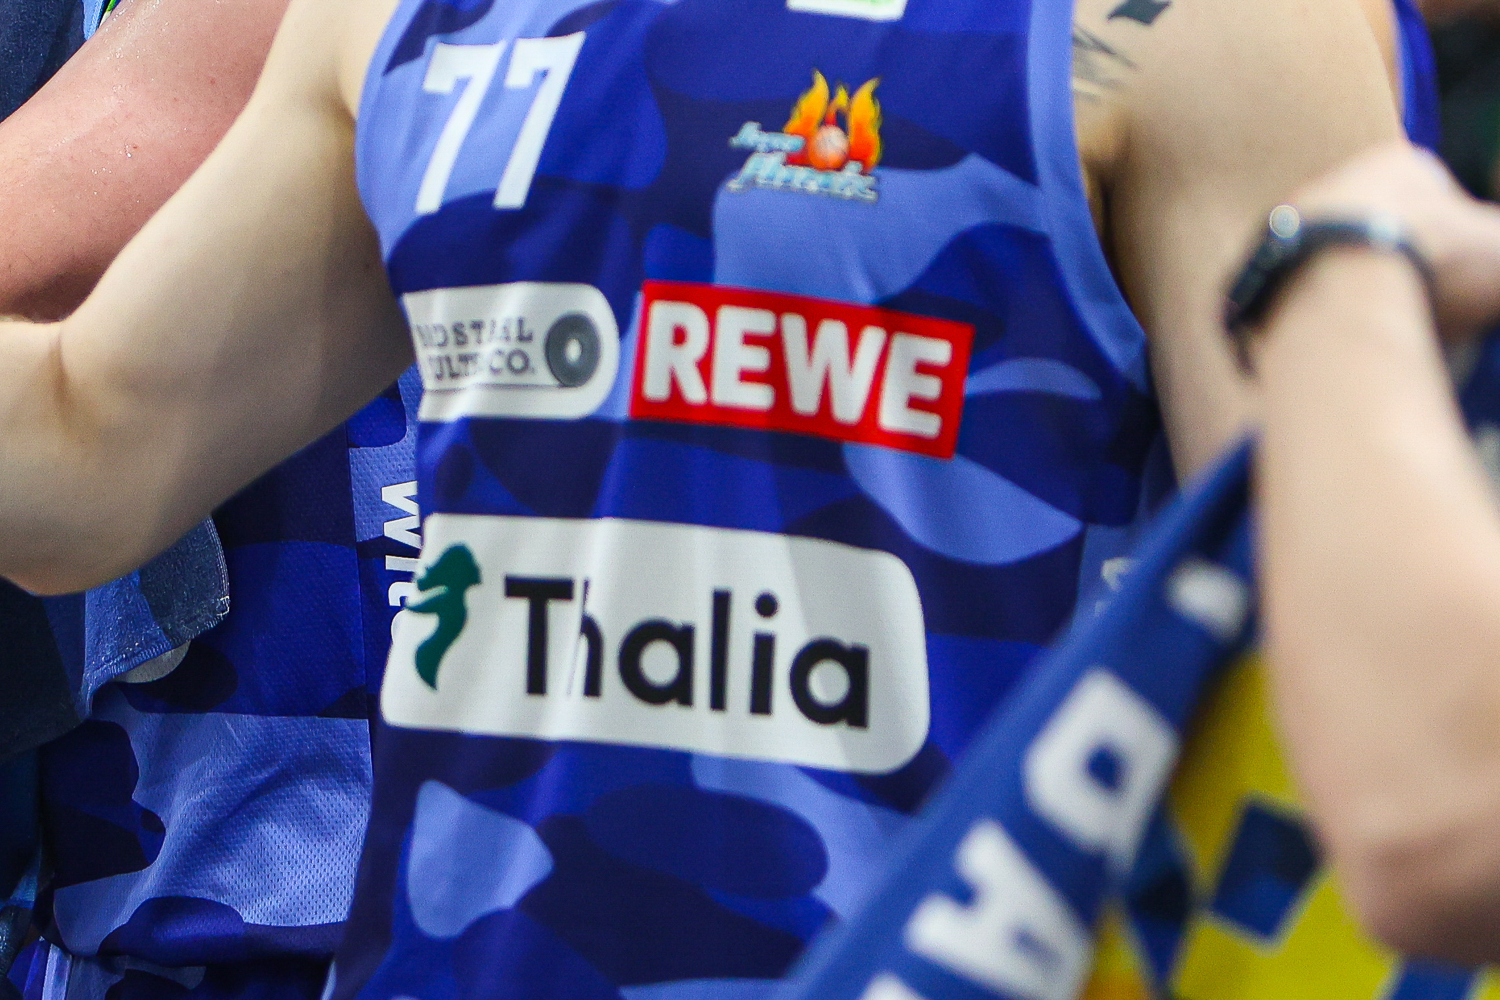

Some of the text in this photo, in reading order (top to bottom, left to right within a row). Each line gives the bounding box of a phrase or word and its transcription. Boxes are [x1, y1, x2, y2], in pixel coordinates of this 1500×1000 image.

[414, 30, 587, 217] 77
[643, 299, 954, 438] REWE
[504, 574, 871, 729] Thalia
